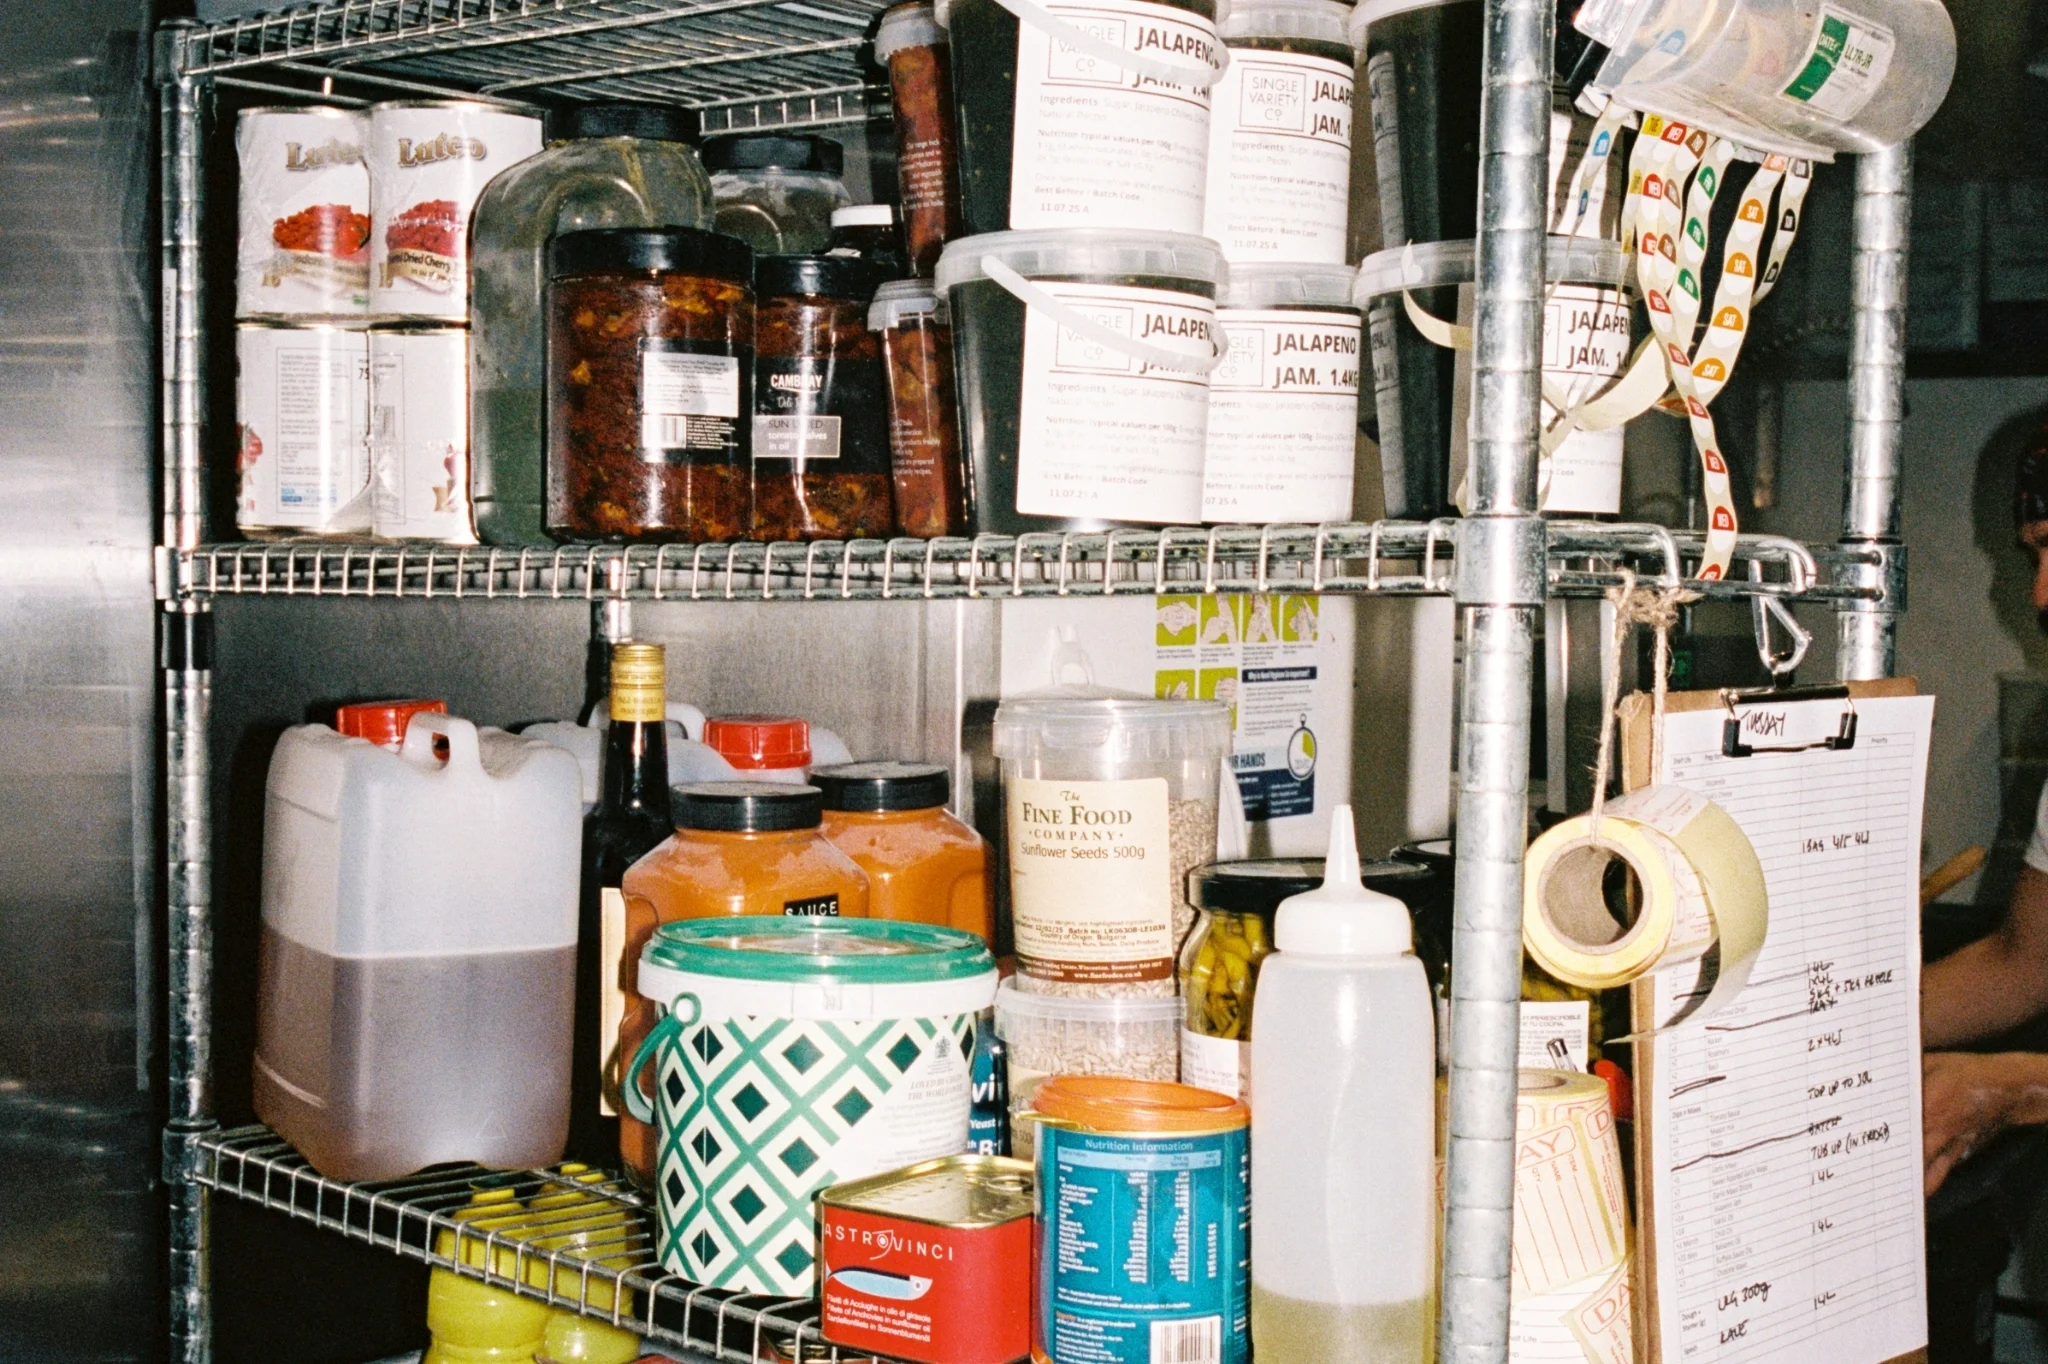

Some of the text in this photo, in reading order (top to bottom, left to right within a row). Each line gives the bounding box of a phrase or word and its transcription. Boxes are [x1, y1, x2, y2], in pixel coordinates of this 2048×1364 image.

[1252, 76, 1299, 93] SINGLE
[1249, 92, 1300, 108] VARIETY
[1310, 112, 1344, 138] JAM.
[397, 131, 488, 169] Luteo
[1746, 205, 1759, 220] SAT
[403, 252, 425, 265] Dried
[1733, 257, 1748, 275] SAT
[1721, 312, 1738, 328] SAT
[1273, 332, 1357, 356] JALAPENO
[1565, 345, 1610, 370] JAM.
[1272, 366, 1322, 390] JAM.
[1701, 363, 1720, 379] SAT
[770, 374, 823, 389] CAMBAY
[768, 420, 789, 429] SUN
[768, 441, 790, 450] in oil
[1240, 752, 1266, 769] HANDS
[1060, 790, 1080, 801] The
[1022, 801, 1133, 826] FINE FOOD
[1033, 828, 1117, 841] COMPANY
[1021, 842, 1146, 860] Sunflower Seeds 500g
[785, 901, 838, 916] SAUCE
[1040, 930, 1063, 941] Country
[1067, 926, 1089, 935] Batch
[1808, 1085, 1826, 1100] TOP
[1842, 1077, 1854, 1088] TO
[970, 1118, 996, 1129] Yeast
[1085, 1139, 1194, 1152] Nutrition Information
[1811, 1143, 1829, 1161] TUB
[1831, 1139, 1842, 1155] UP
[1568, 1152, 1578, 1173] ITEM
[1531, 1167, 1542, 1182] QTY
[1551, 1160, 1562, 1182] NAME
[843, 1297, 850, 1306] di
[850, 1298, 879, 1312] Acciughe
[879, 1304, 886, 1312] in
[886, 1306, 898, 1316] olio
[899, 1309, 906, 1317] di
[906, 1311, 932, 1323] girasole
[1681, 1310, 1698, 1321] Dough
[844, 1307, 852, 1316] of
[851, 1308, 884, 1322] Anchovies
[884, 1314, 891, 1323] in
[891, 1316, 923, 1331] sunflower
[923, 1323, 931, 1333] oil
[869, 1321, 877, 1330] in
